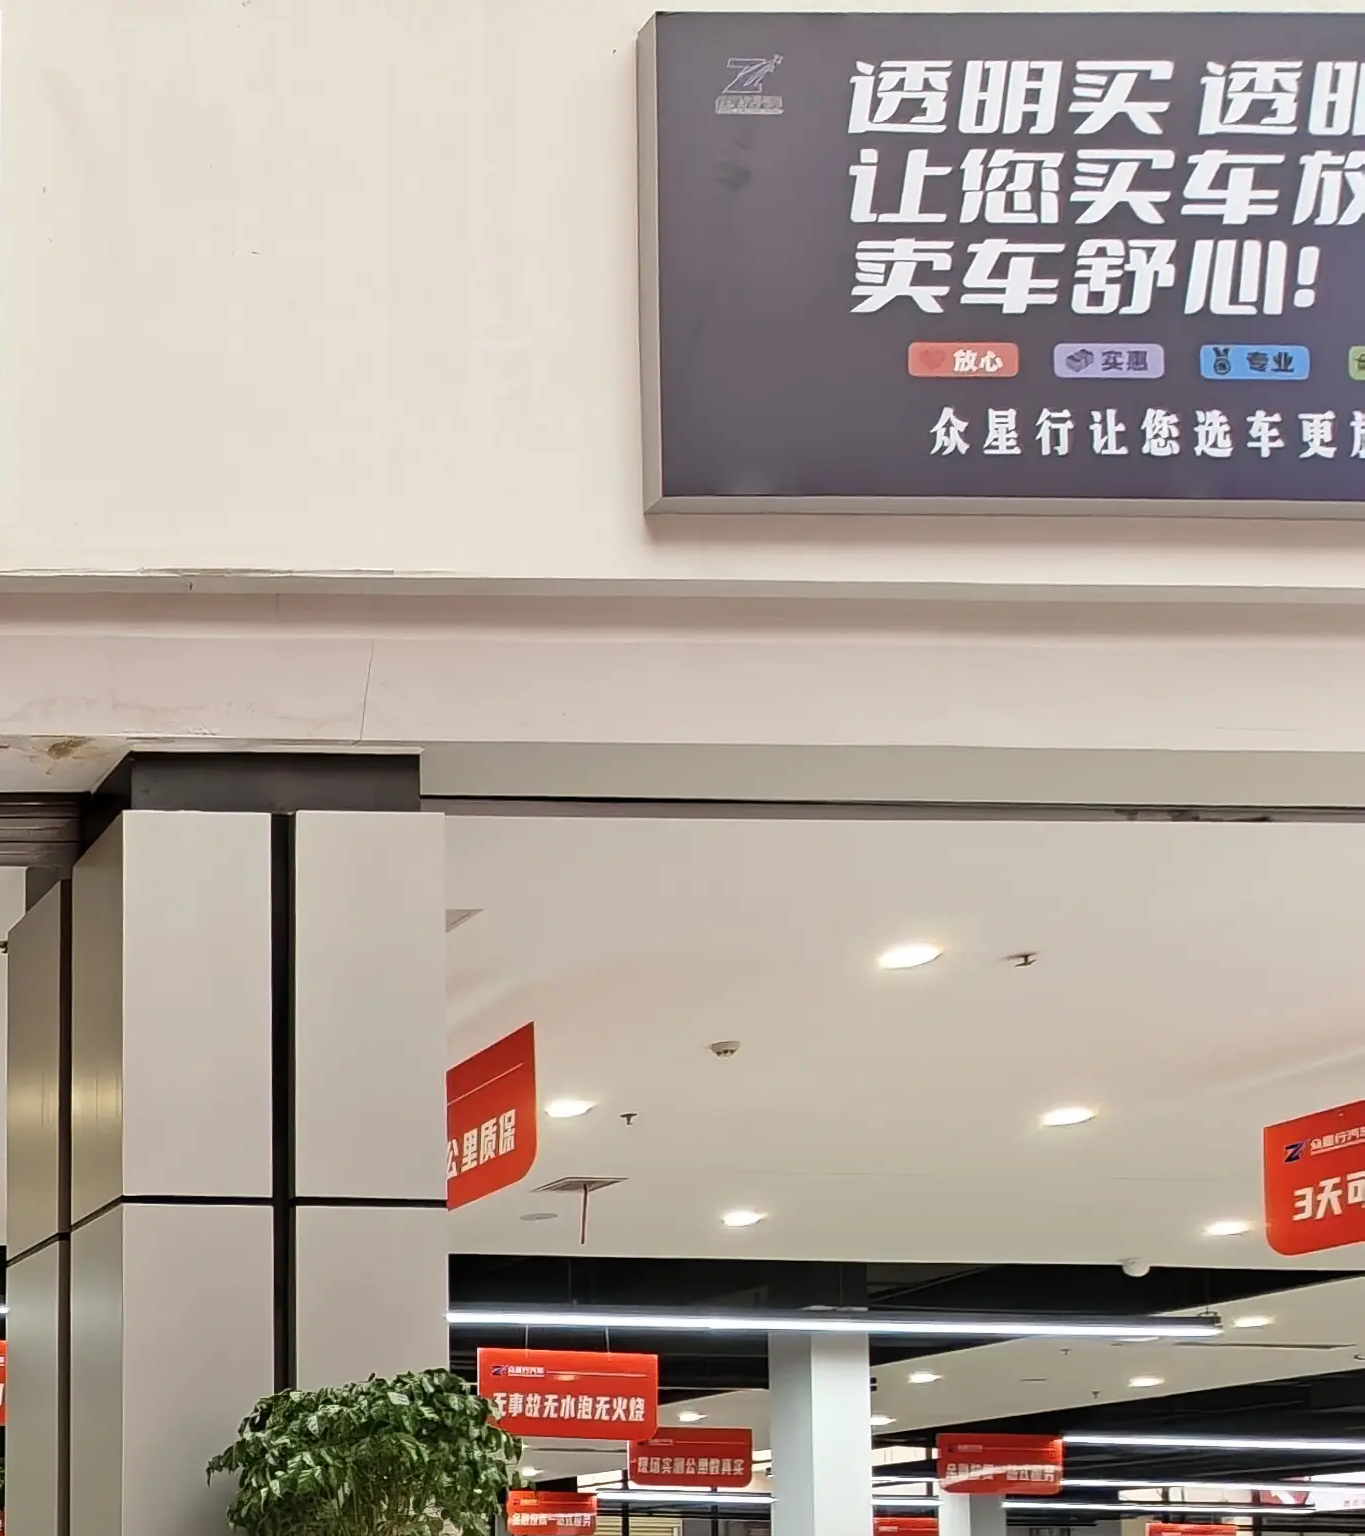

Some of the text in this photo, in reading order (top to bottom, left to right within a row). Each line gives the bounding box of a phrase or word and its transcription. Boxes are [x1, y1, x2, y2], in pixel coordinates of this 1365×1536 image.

[847, 60, 1175, 137] 透明买
[849, 149, 1365, 226] 让您买车放
[850, 237, 1320, 315] 卖车舒心!
[953, 349, 1004, 375] 放心
[1100, 349, 1150, 373] 实惠
[1246, 350, 1295, 375] 专业
